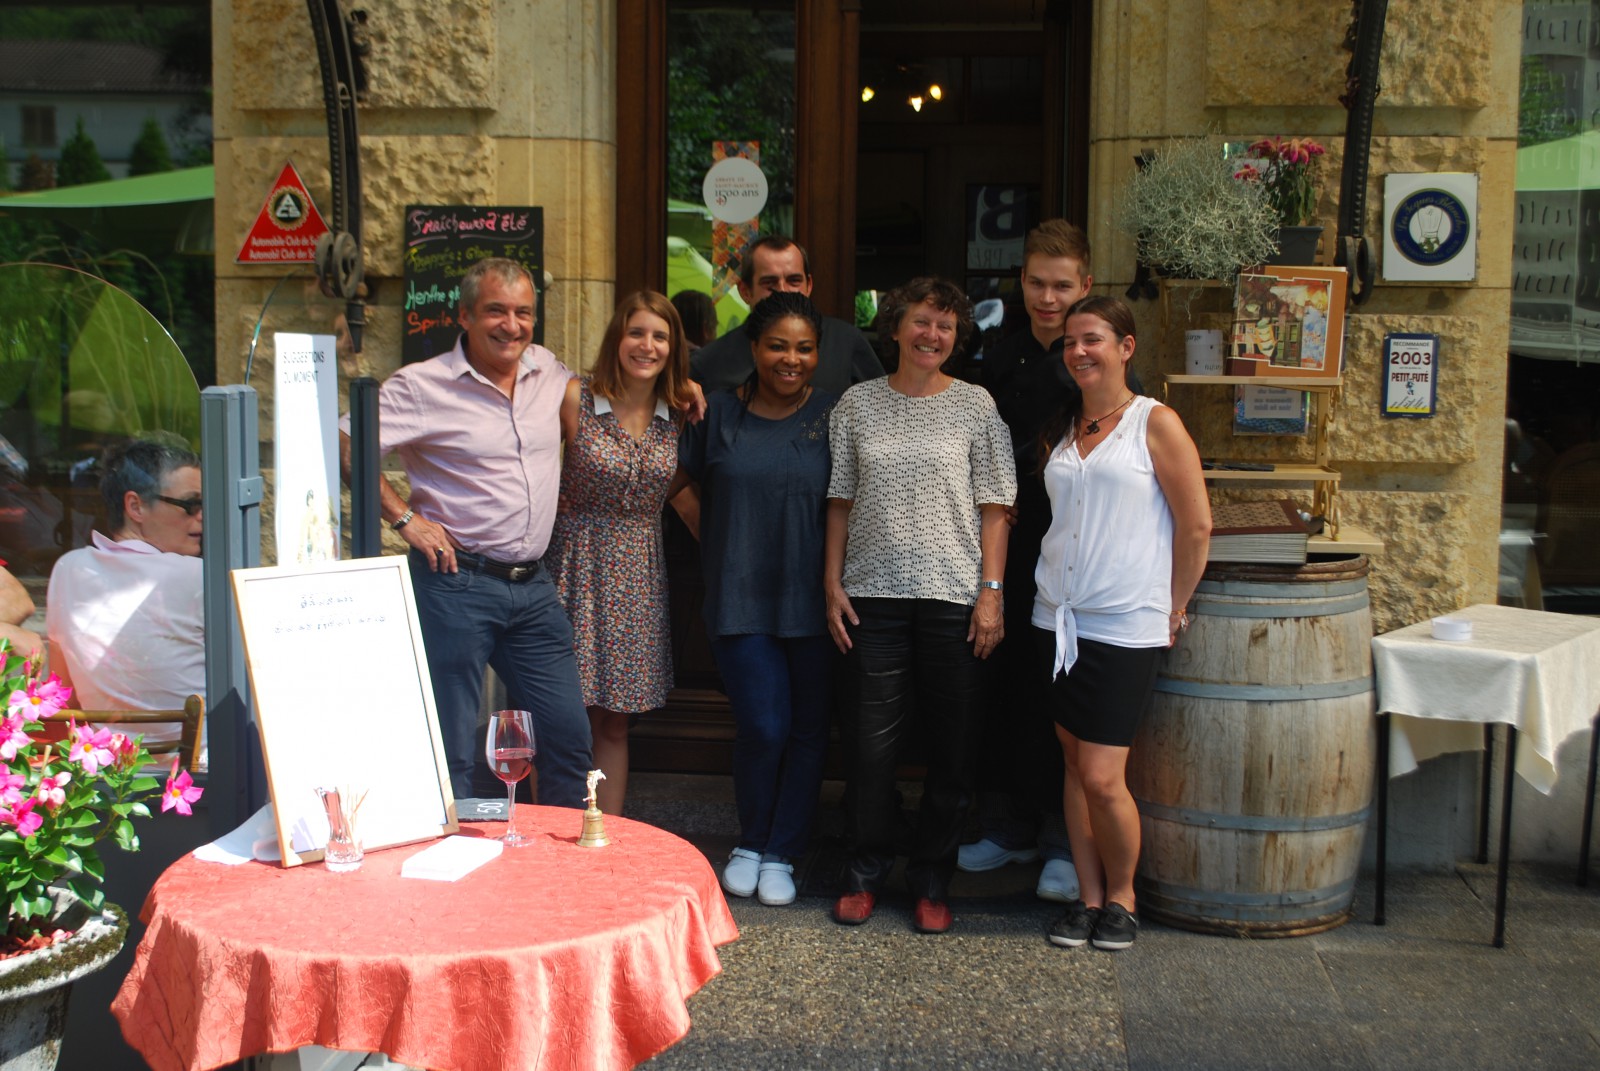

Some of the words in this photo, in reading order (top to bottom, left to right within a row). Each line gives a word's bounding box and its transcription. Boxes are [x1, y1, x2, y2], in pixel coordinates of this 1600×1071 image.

[742, 189, 759, 197] ans
[252, 236, 285, 246] Automobile
[286, 236, 300, 246] Club
[301, 236, 309, 246] de
[249, 248, 279, 258] Automobil
[281, 248, 296, 258] Club
[298, 248, 307, 258] der
[1391, 352, 1431, 365] 2003
[476, 802, 504, 814] 50
